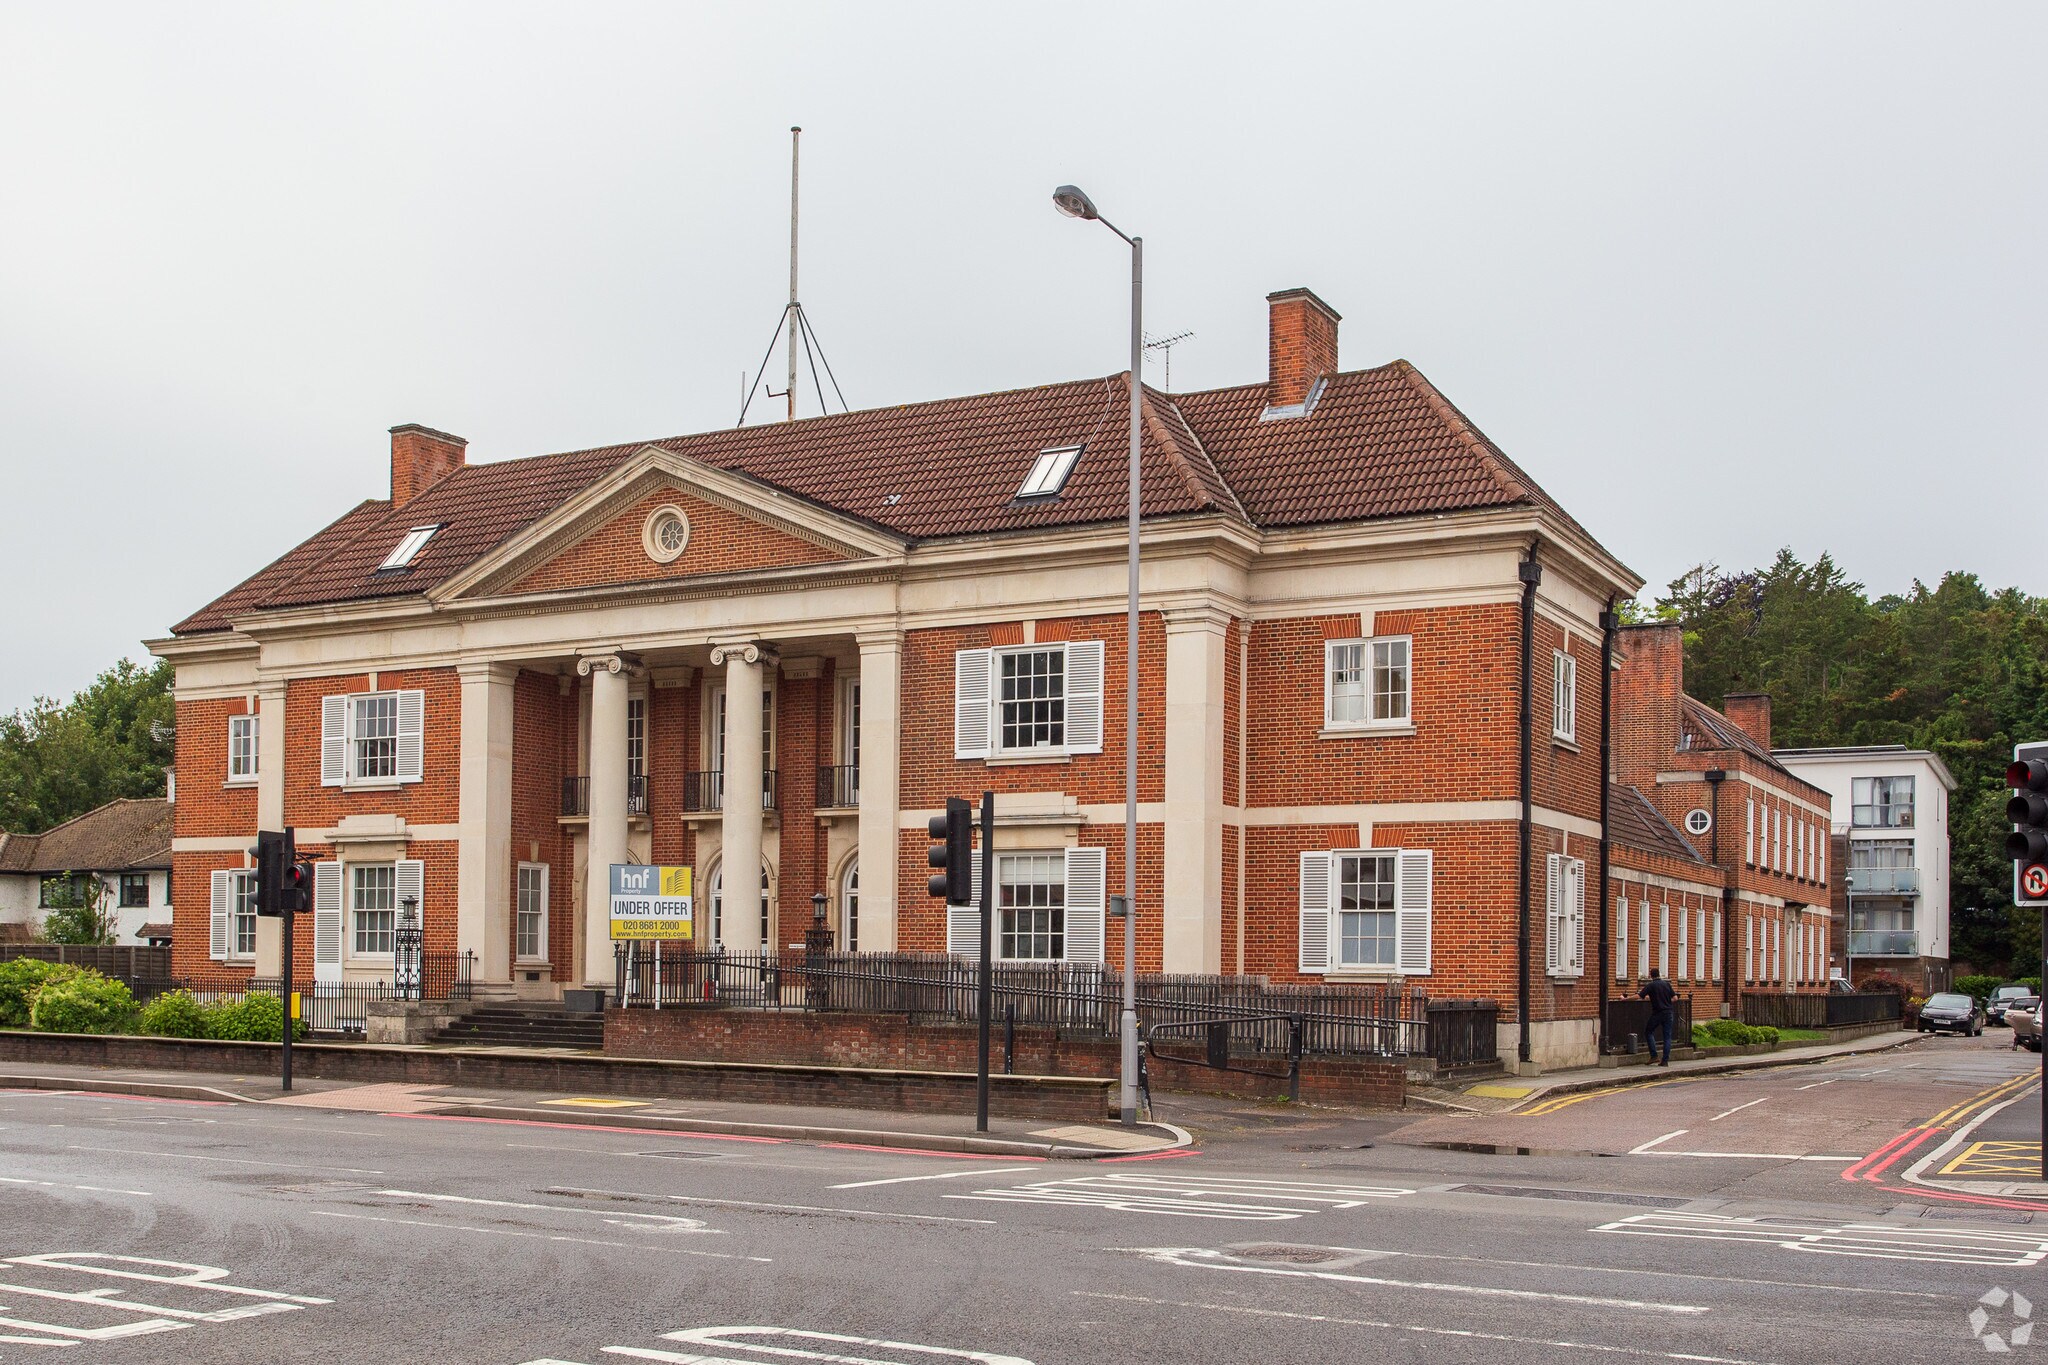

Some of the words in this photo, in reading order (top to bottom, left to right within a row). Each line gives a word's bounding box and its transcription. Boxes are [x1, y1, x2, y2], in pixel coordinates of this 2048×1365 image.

[621, 868, 649, 888] hnf
[614, 901, 650, 915] UNDER
[654, 901, 688, 915] OFFER
[623, 921, 638, 930] 020
[639, 921, 658, 930] 8681
[660, 921, 680, 930] 2000
